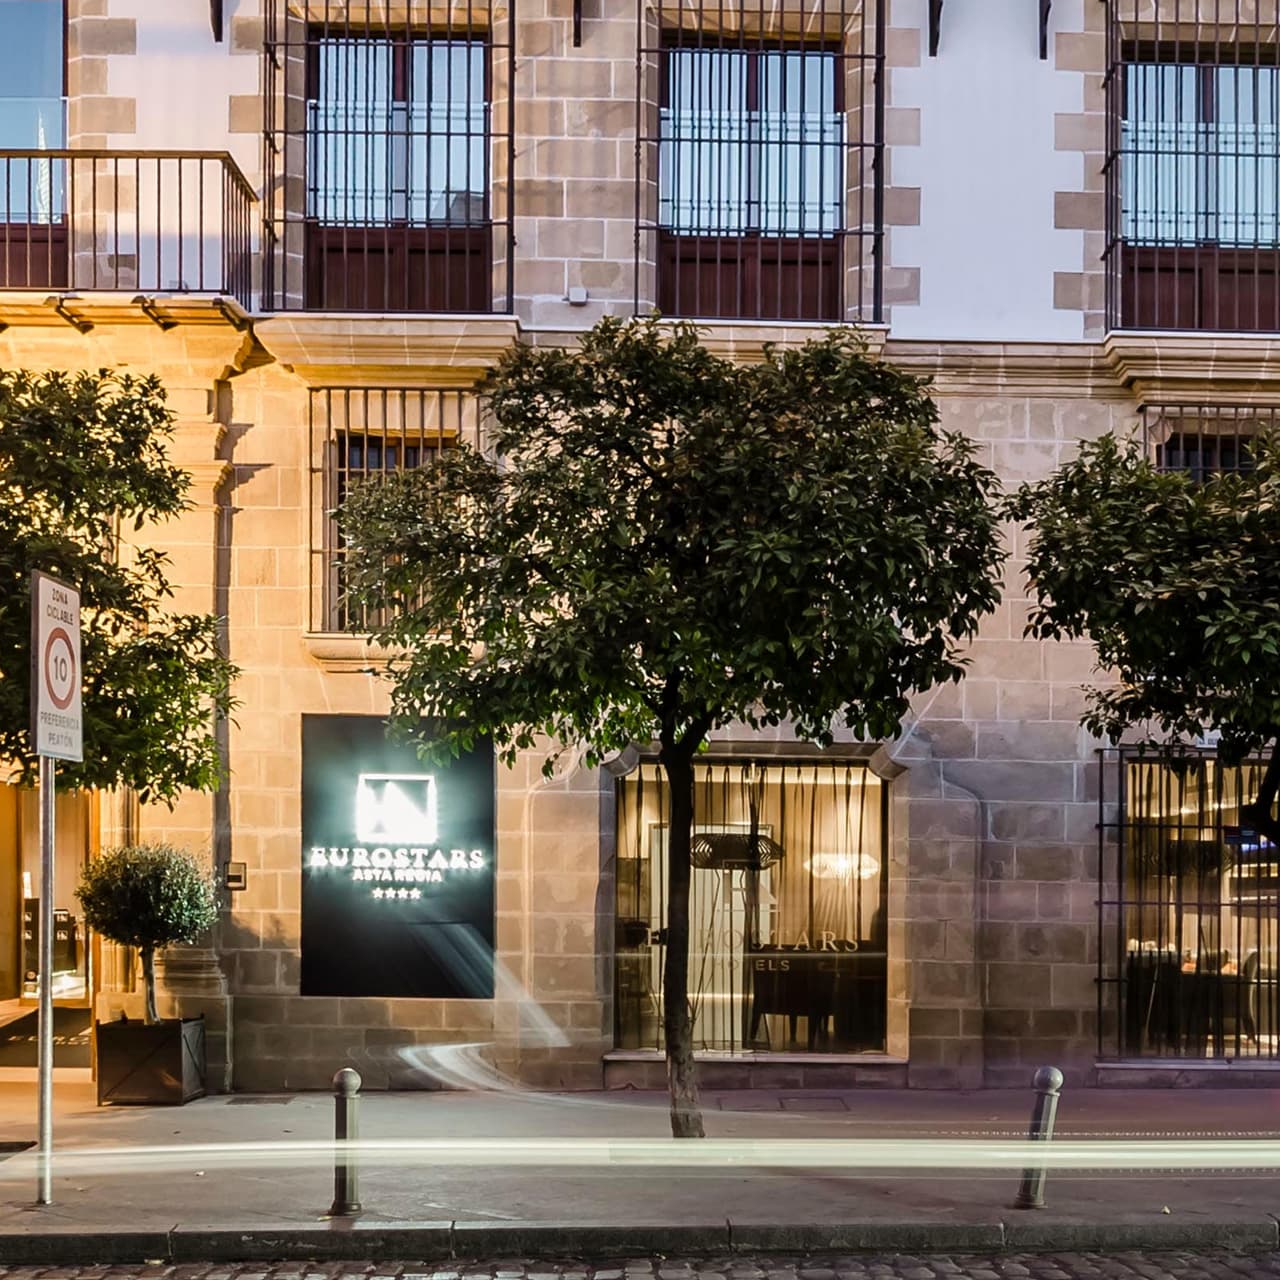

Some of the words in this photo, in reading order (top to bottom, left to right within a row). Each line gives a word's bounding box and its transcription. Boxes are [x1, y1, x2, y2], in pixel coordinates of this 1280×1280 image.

[52, 588, 68, 605] ZONA
[47, 605, 74, 625] CICLABLE
[53, 655, 68, 683] 10
[40, 711, 79, 730] PREFERENCIA
[310, 847, 485, 869] EUROSTARS
[352, 868, 392, 881] ASTA
[647, 927, 860, 953] EROSTARS
